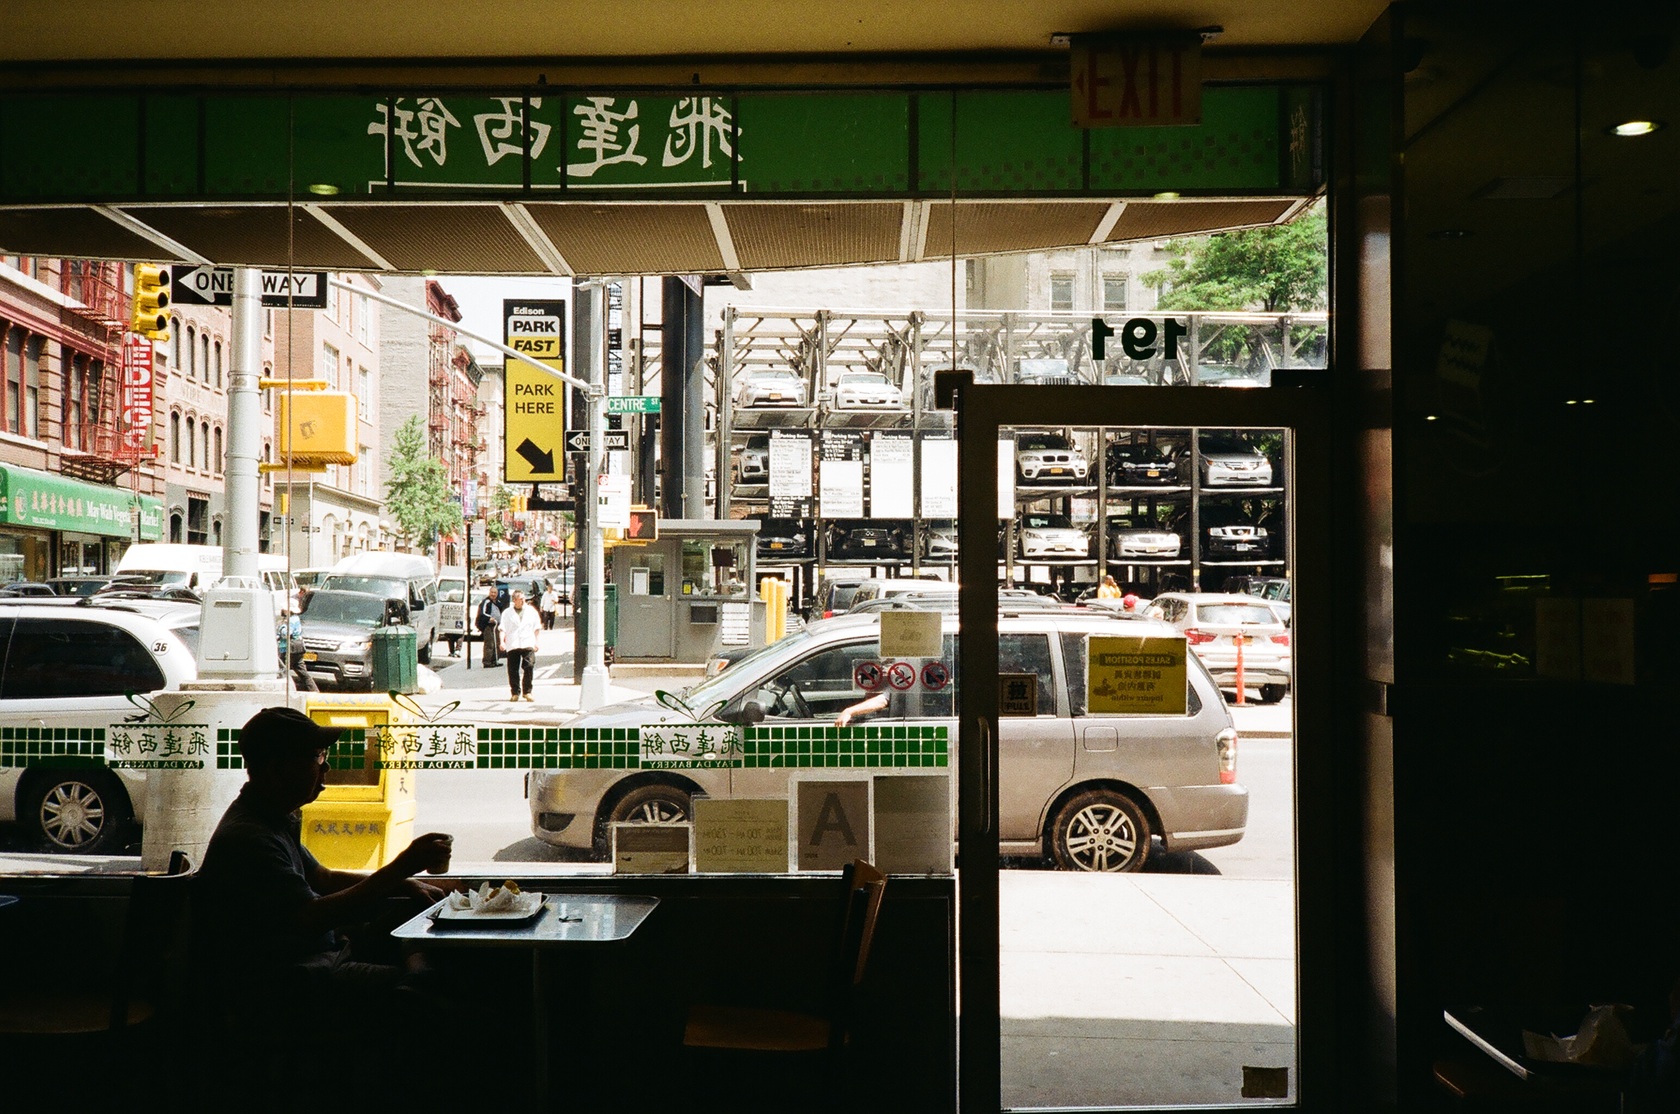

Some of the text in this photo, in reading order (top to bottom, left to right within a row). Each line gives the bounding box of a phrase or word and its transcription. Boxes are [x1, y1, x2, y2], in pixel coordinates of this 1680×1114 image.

[1088, 46, 1187, 118] EXIT
[262, 275, 307, 294] WAY
[513, 306, 545, 315] Edison
[513, 320, 556, 333] PARK
[513, 340, 555, 352] FAST
[515, 383, 554, 396] PARK
[515, 402, 555, 415] HERE
[608, 398, 646, 411] CENTRE
[604, 437, 621, 445] AY
[154, 642, 168, 652] 36
